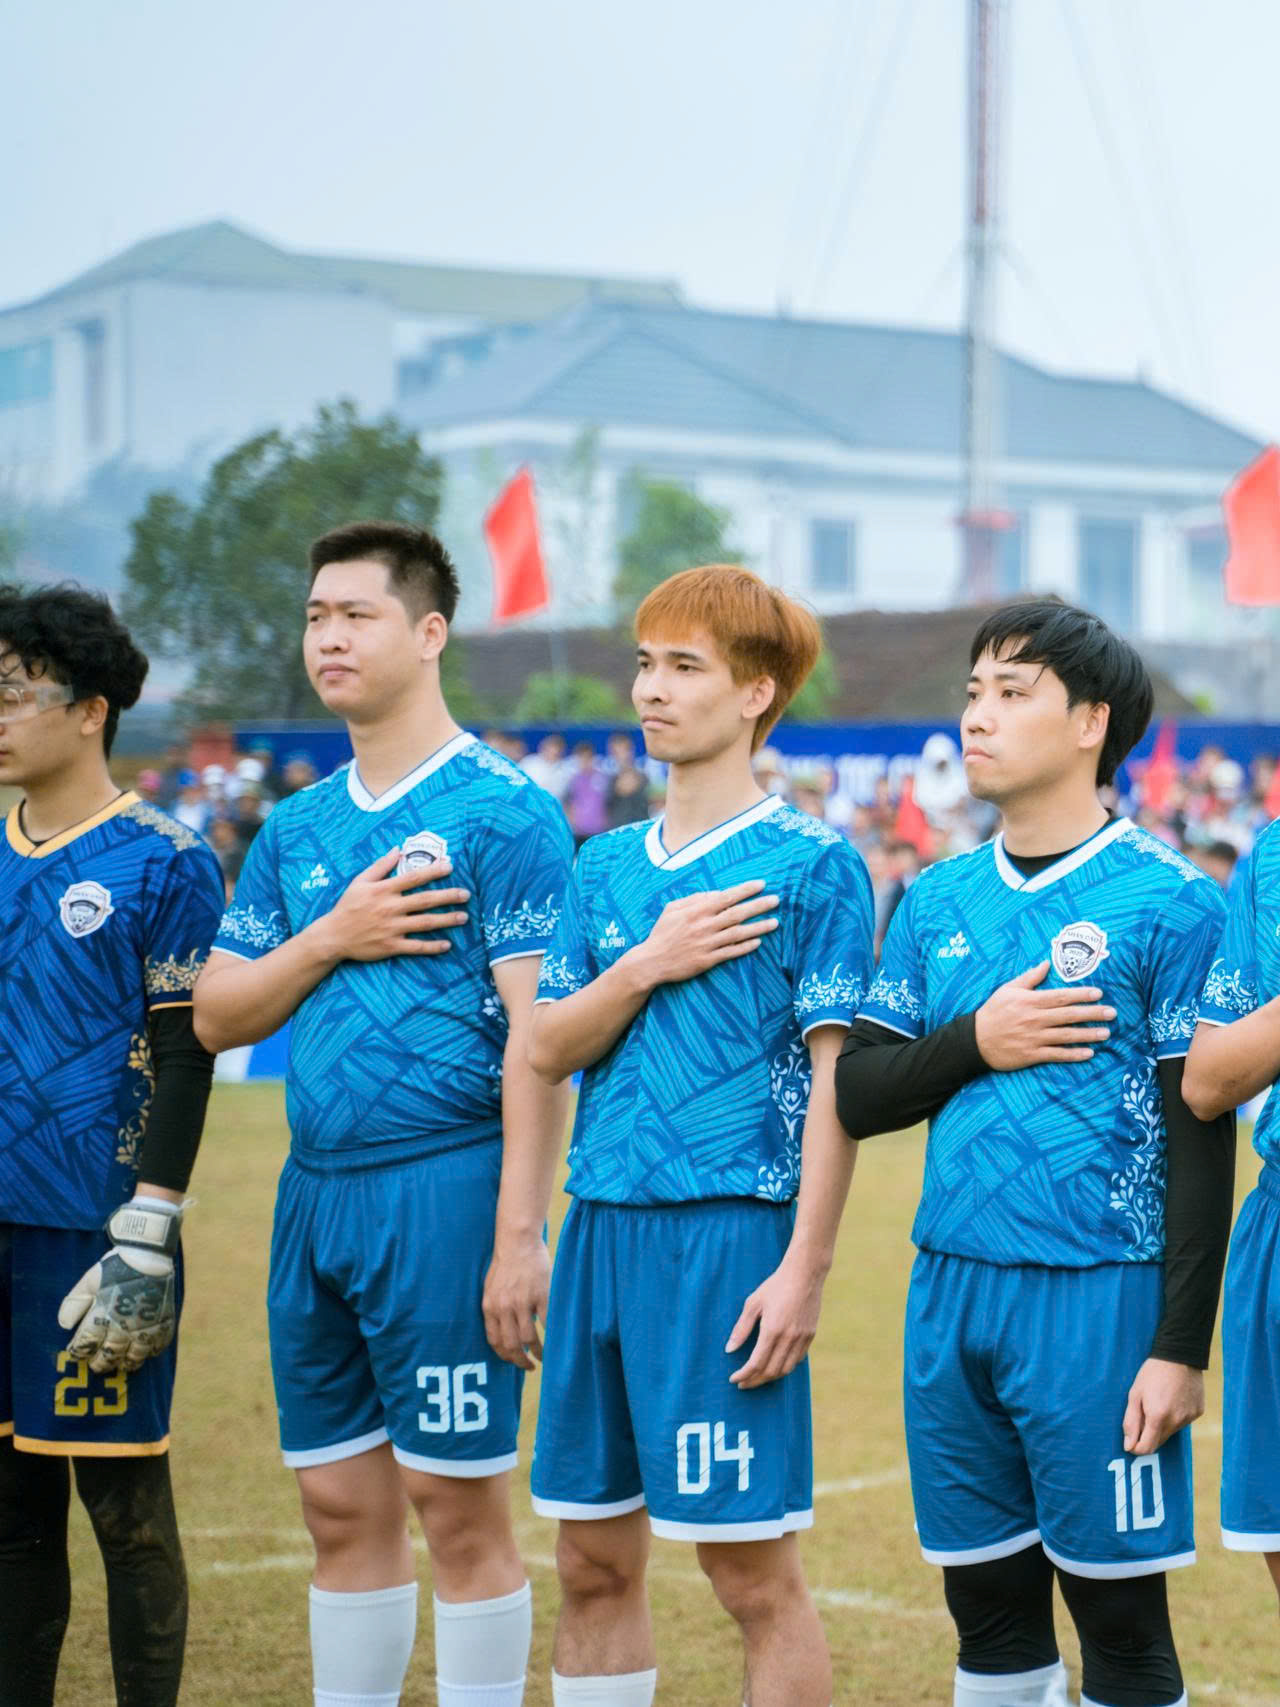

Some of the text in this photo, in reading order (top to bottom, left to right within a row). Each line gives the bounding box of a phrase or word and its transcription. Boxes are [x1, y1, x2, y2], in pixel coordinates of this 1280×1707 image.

[54, 1350, 128, 1417] 23
[416, 1362, 488, 1433] 36
[677, 1421, 754, 1494] 04
[1107, 1453, 1165, 1533] 10
